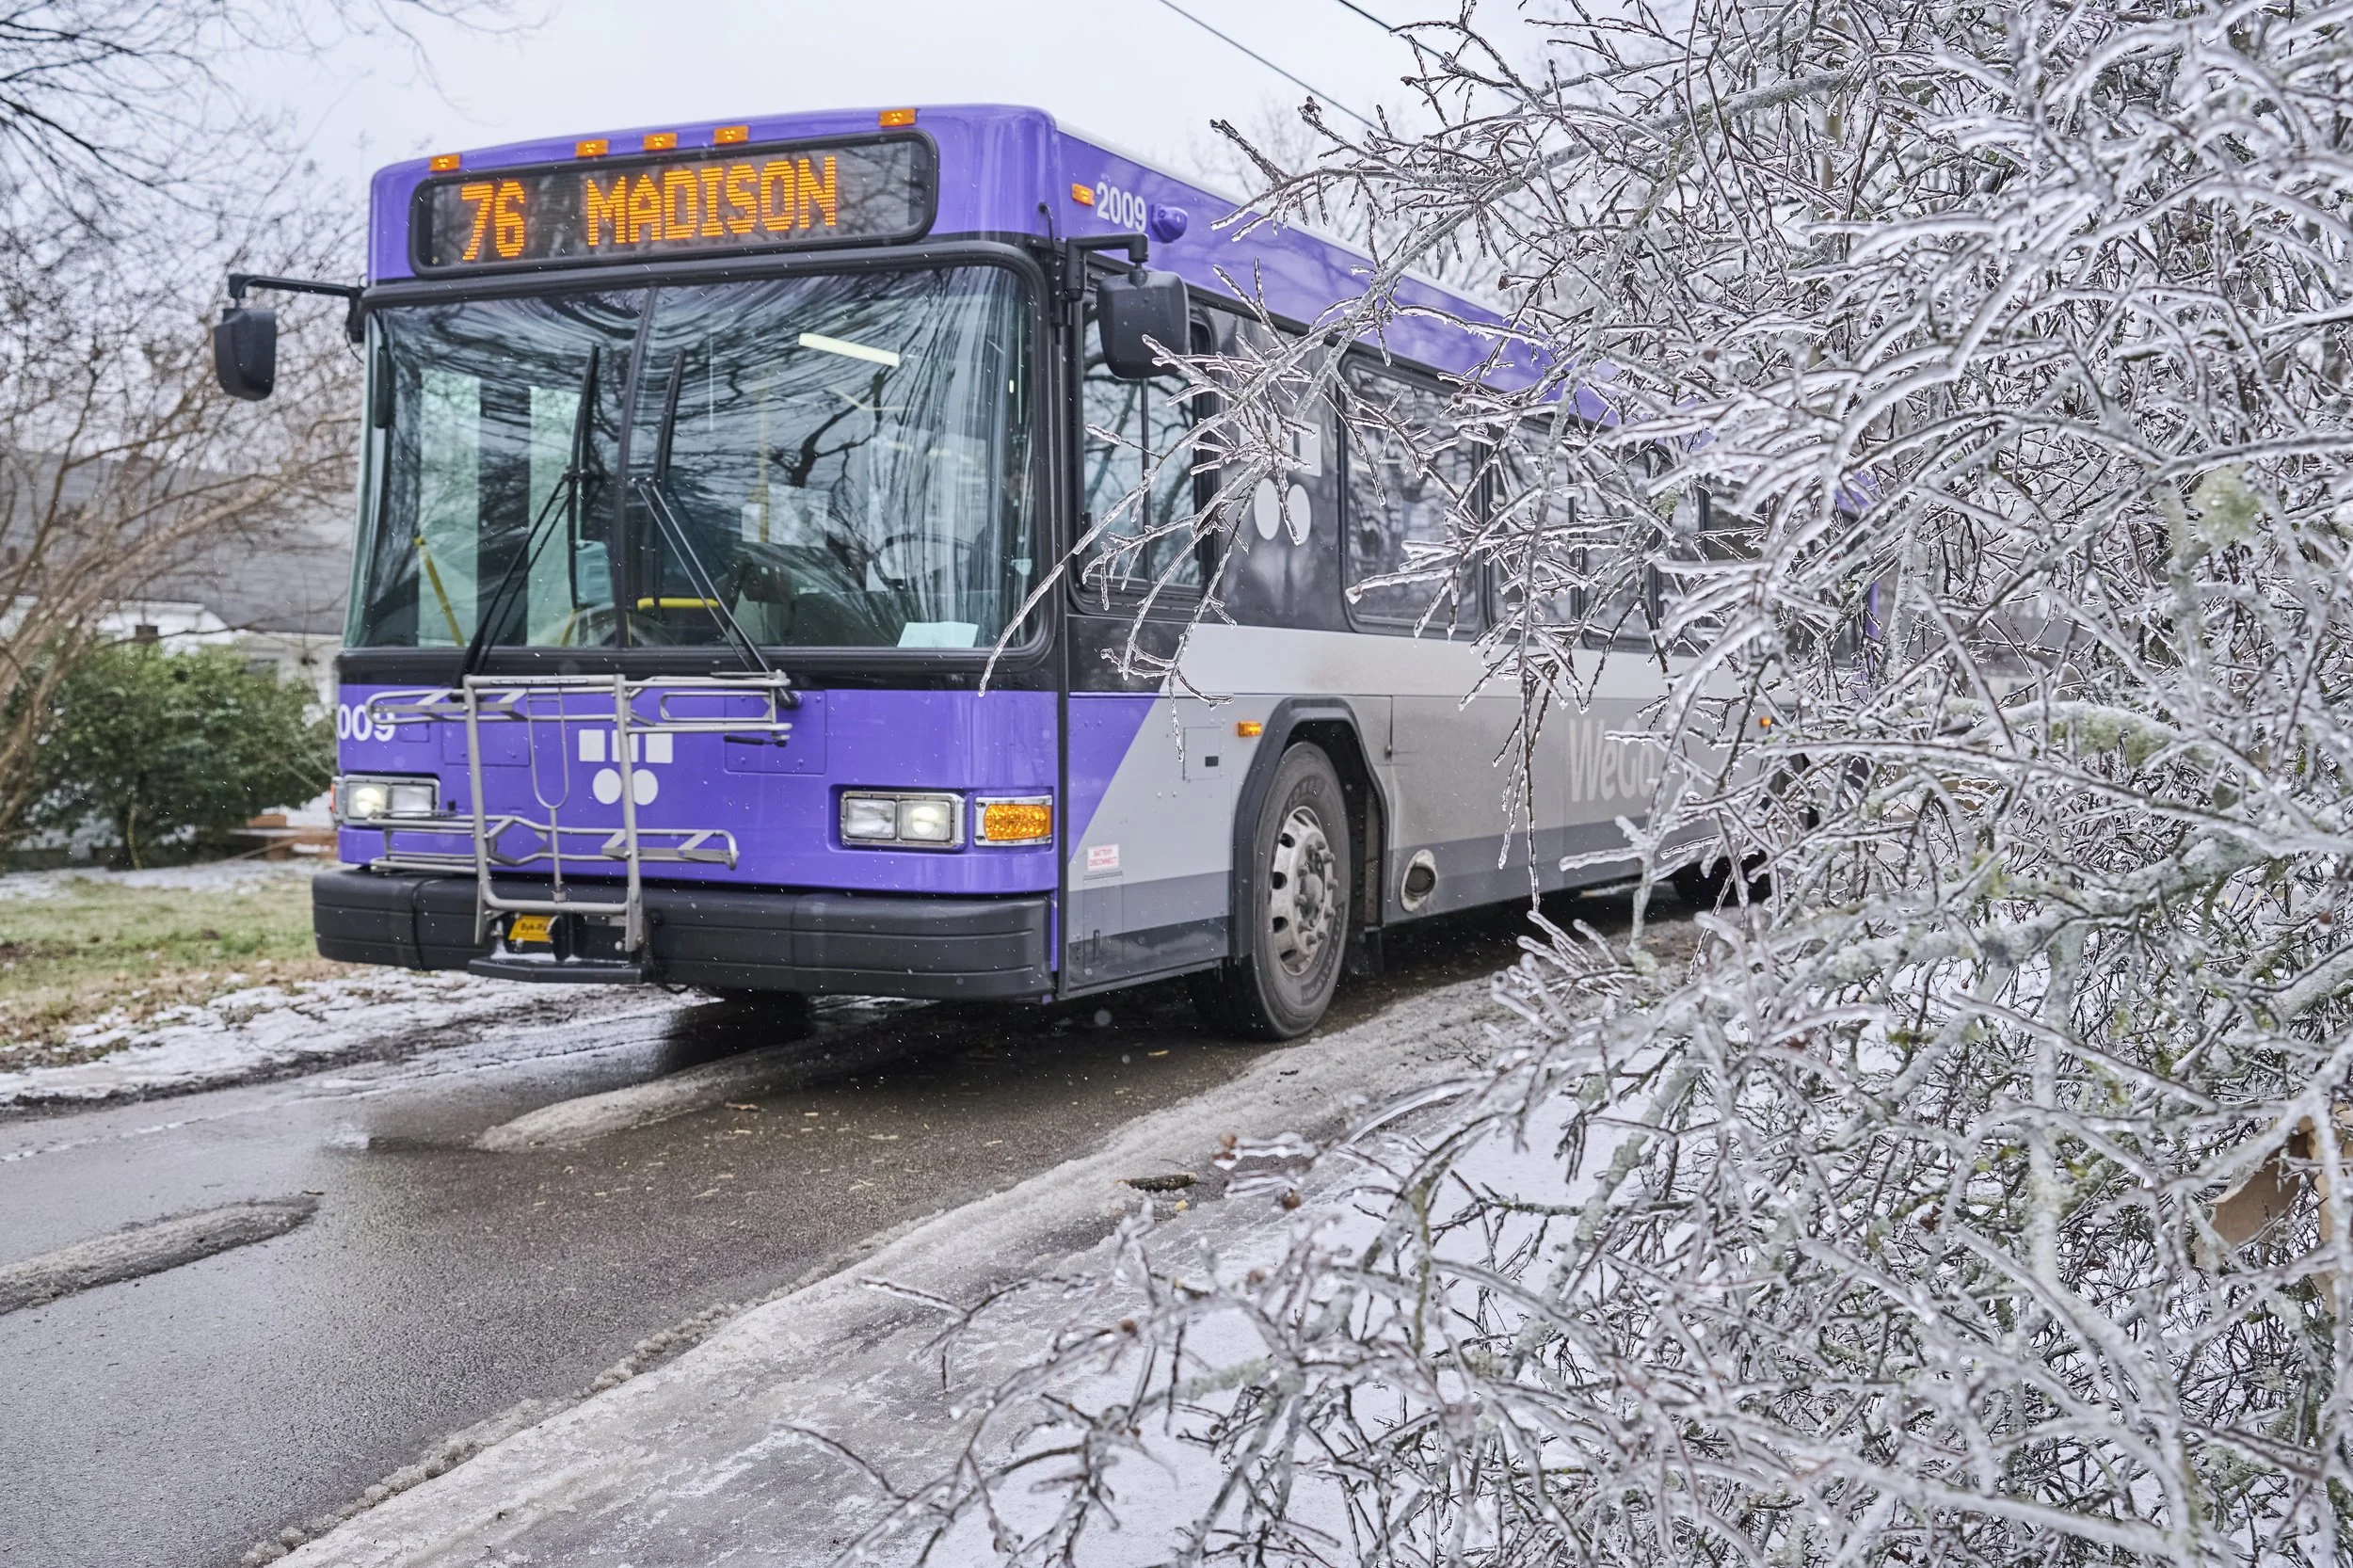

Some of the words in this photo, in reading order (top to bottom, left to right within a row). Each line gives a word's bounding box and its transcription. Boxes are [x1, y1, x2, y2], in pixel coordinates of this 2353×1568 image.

[461, 181, 526, 262] 76
[586, 155, 837, 247] MADISON
[1096, 182, 1147, 232] 2009
[1569, 717, 1655, 802] WeGo
